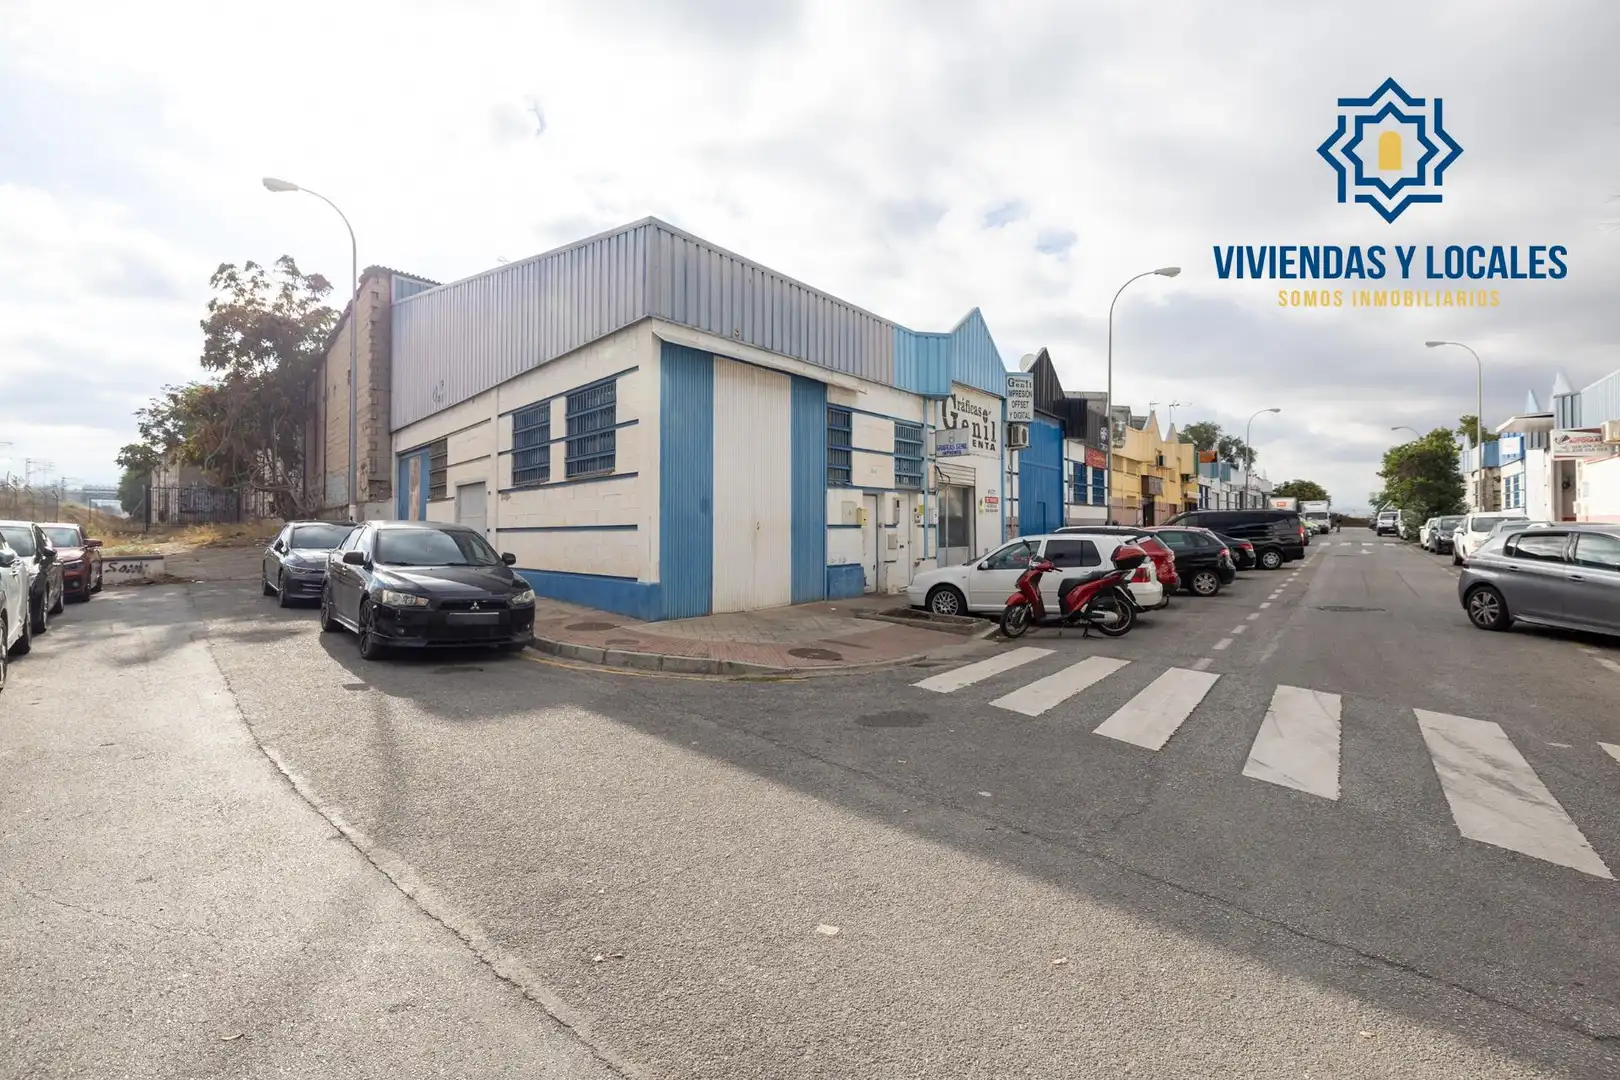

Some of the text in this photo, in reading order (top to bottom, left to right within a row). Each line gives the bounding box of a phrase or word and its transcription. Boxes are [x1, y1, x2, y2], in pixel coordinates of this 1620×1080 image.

[1011, 400, 1029, 408] OFFSET
[1013, 411, 1031, 419] DIGITAL
[972, 439, 996, 451] ENTA
